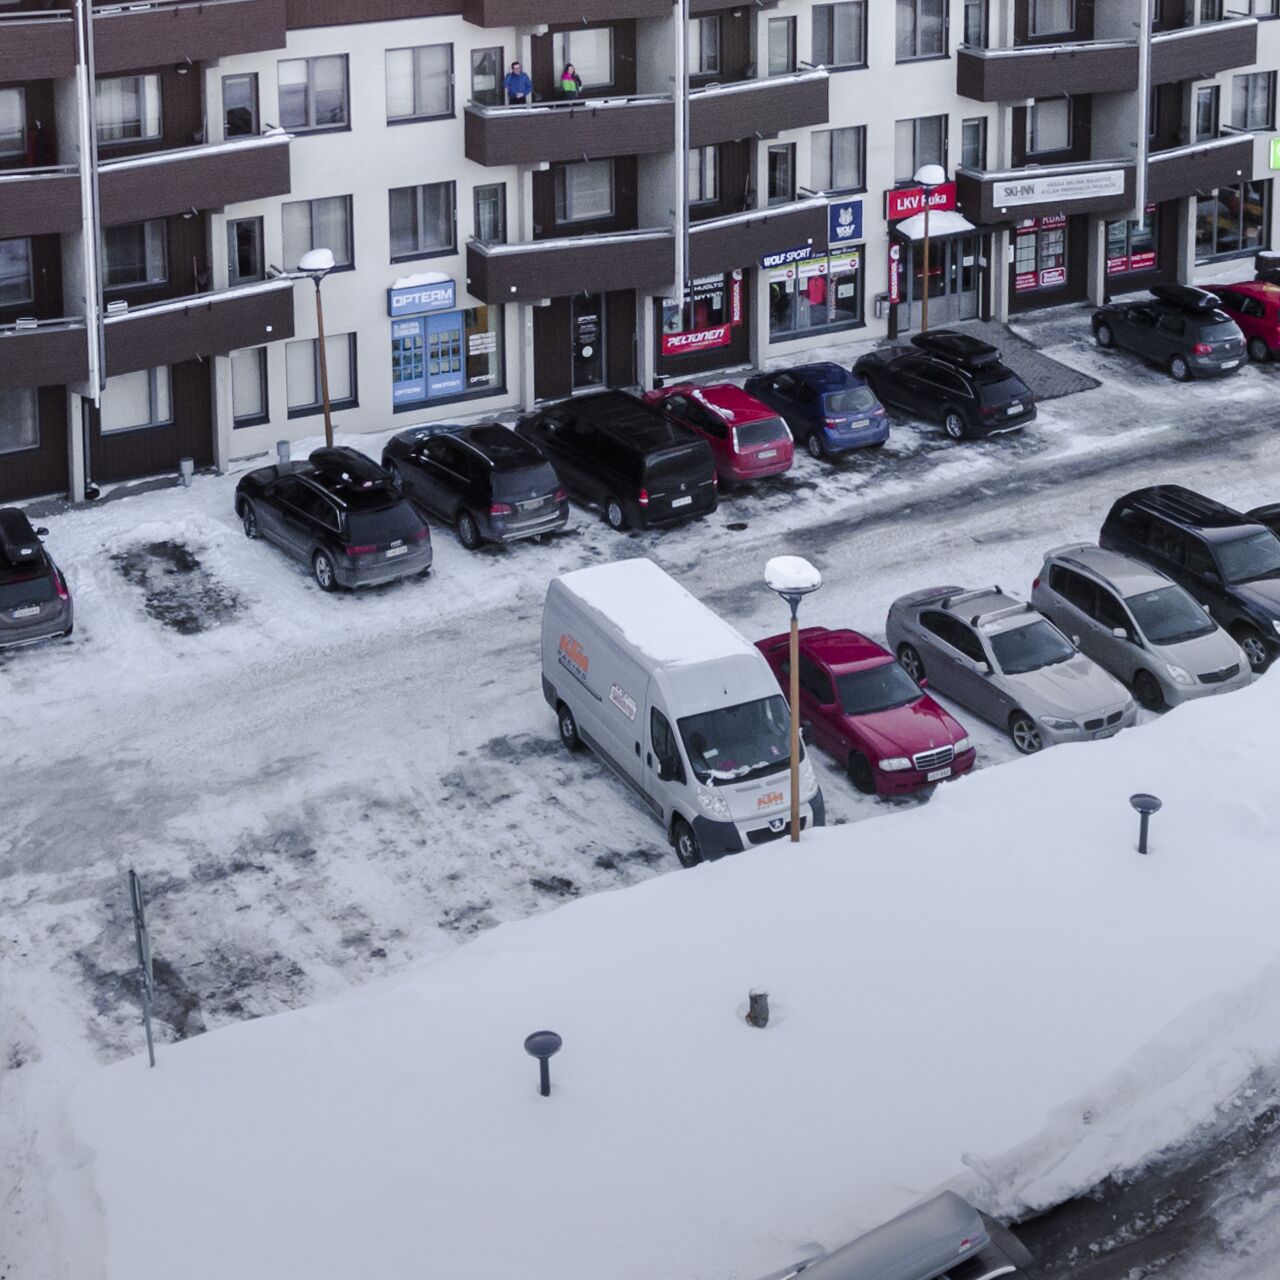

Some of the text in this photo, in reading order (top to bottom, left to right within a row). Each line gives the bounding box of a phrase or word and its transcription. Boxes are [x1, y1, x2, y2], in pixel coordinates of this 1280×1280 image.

[1004, 184, 1035, 198] SKI-INN
[897, 195, 920, 211] LKV
[763, 253, 786, 267] WOLF
[786, 247, 812, 262] SPORT
[392, 287, 453, 308] OPTERM
[667, 328, 725, 347] PELTONEN
